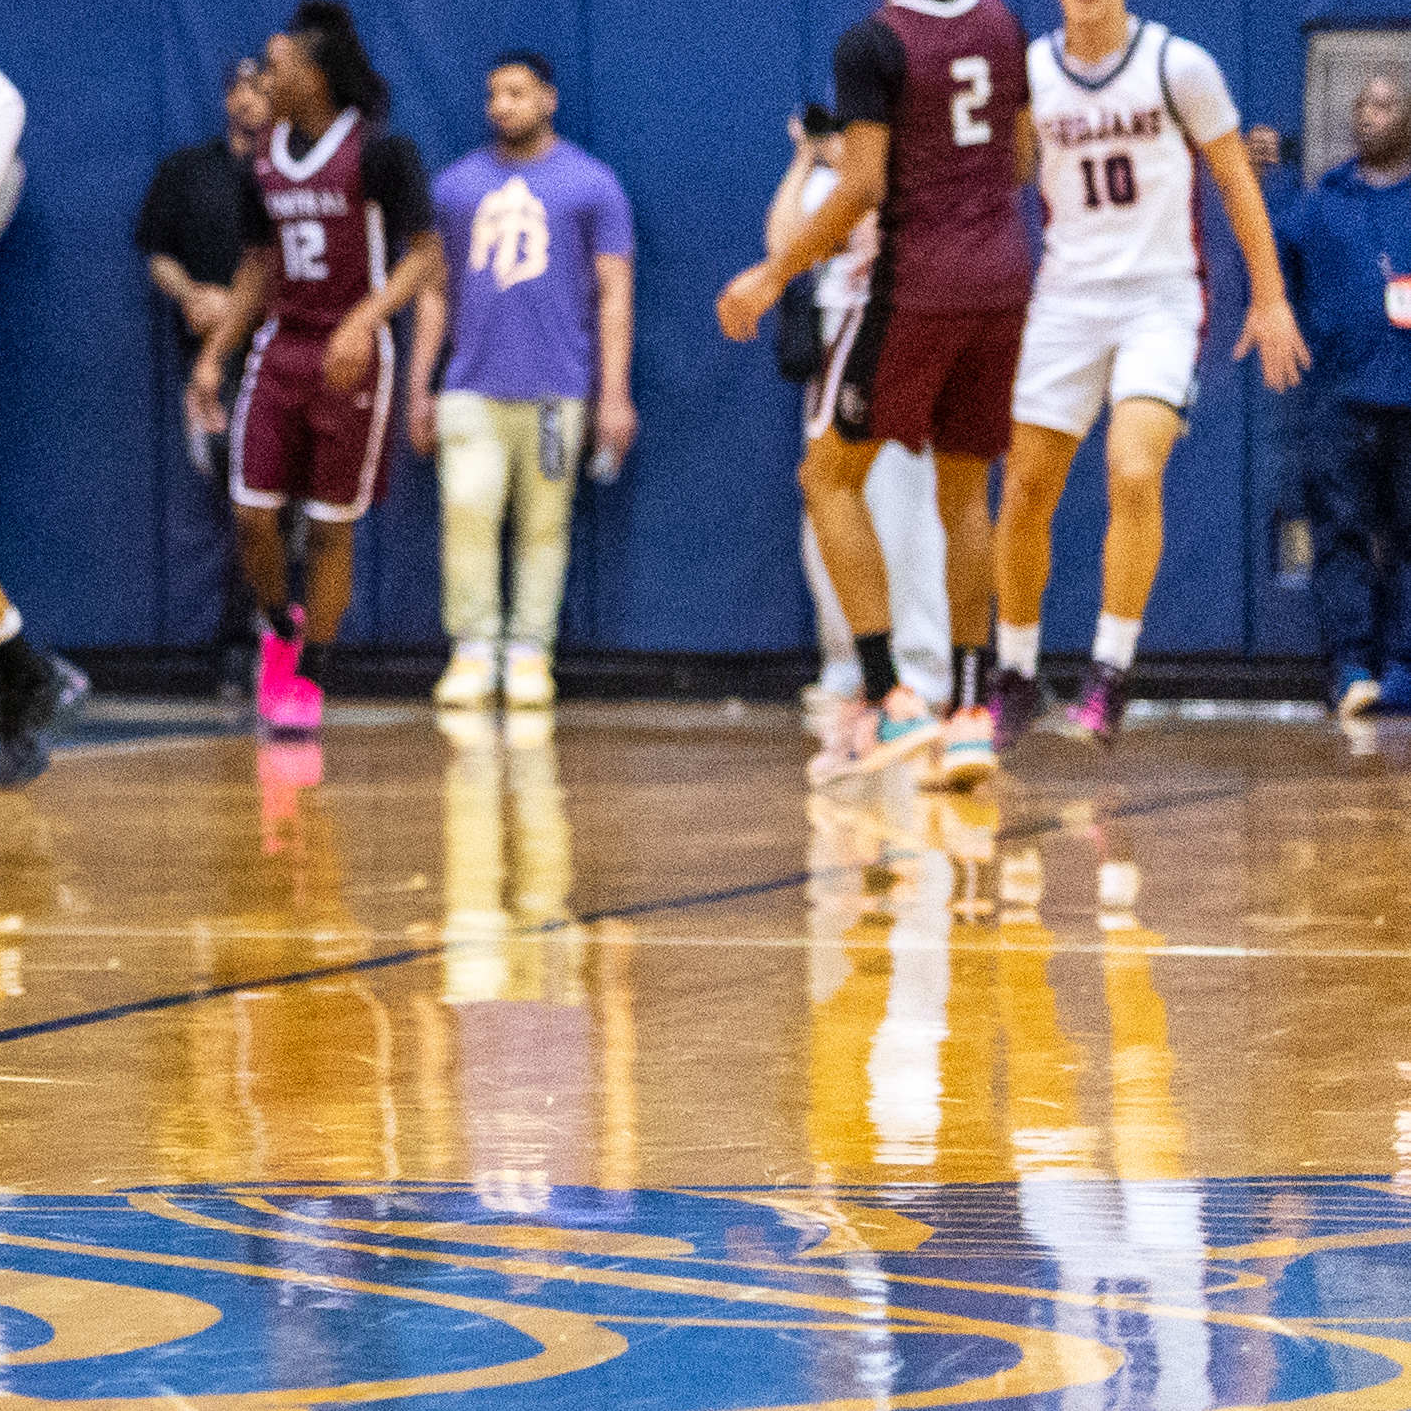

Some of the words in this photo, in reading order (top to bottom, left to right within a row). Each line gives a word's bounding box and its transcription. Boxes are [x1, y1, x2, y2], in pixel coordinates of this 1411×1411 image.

[950, 57, 993, 147] 2
[1080, 151, 1140, 212] 10
[281, 219, 331, 282] 12
